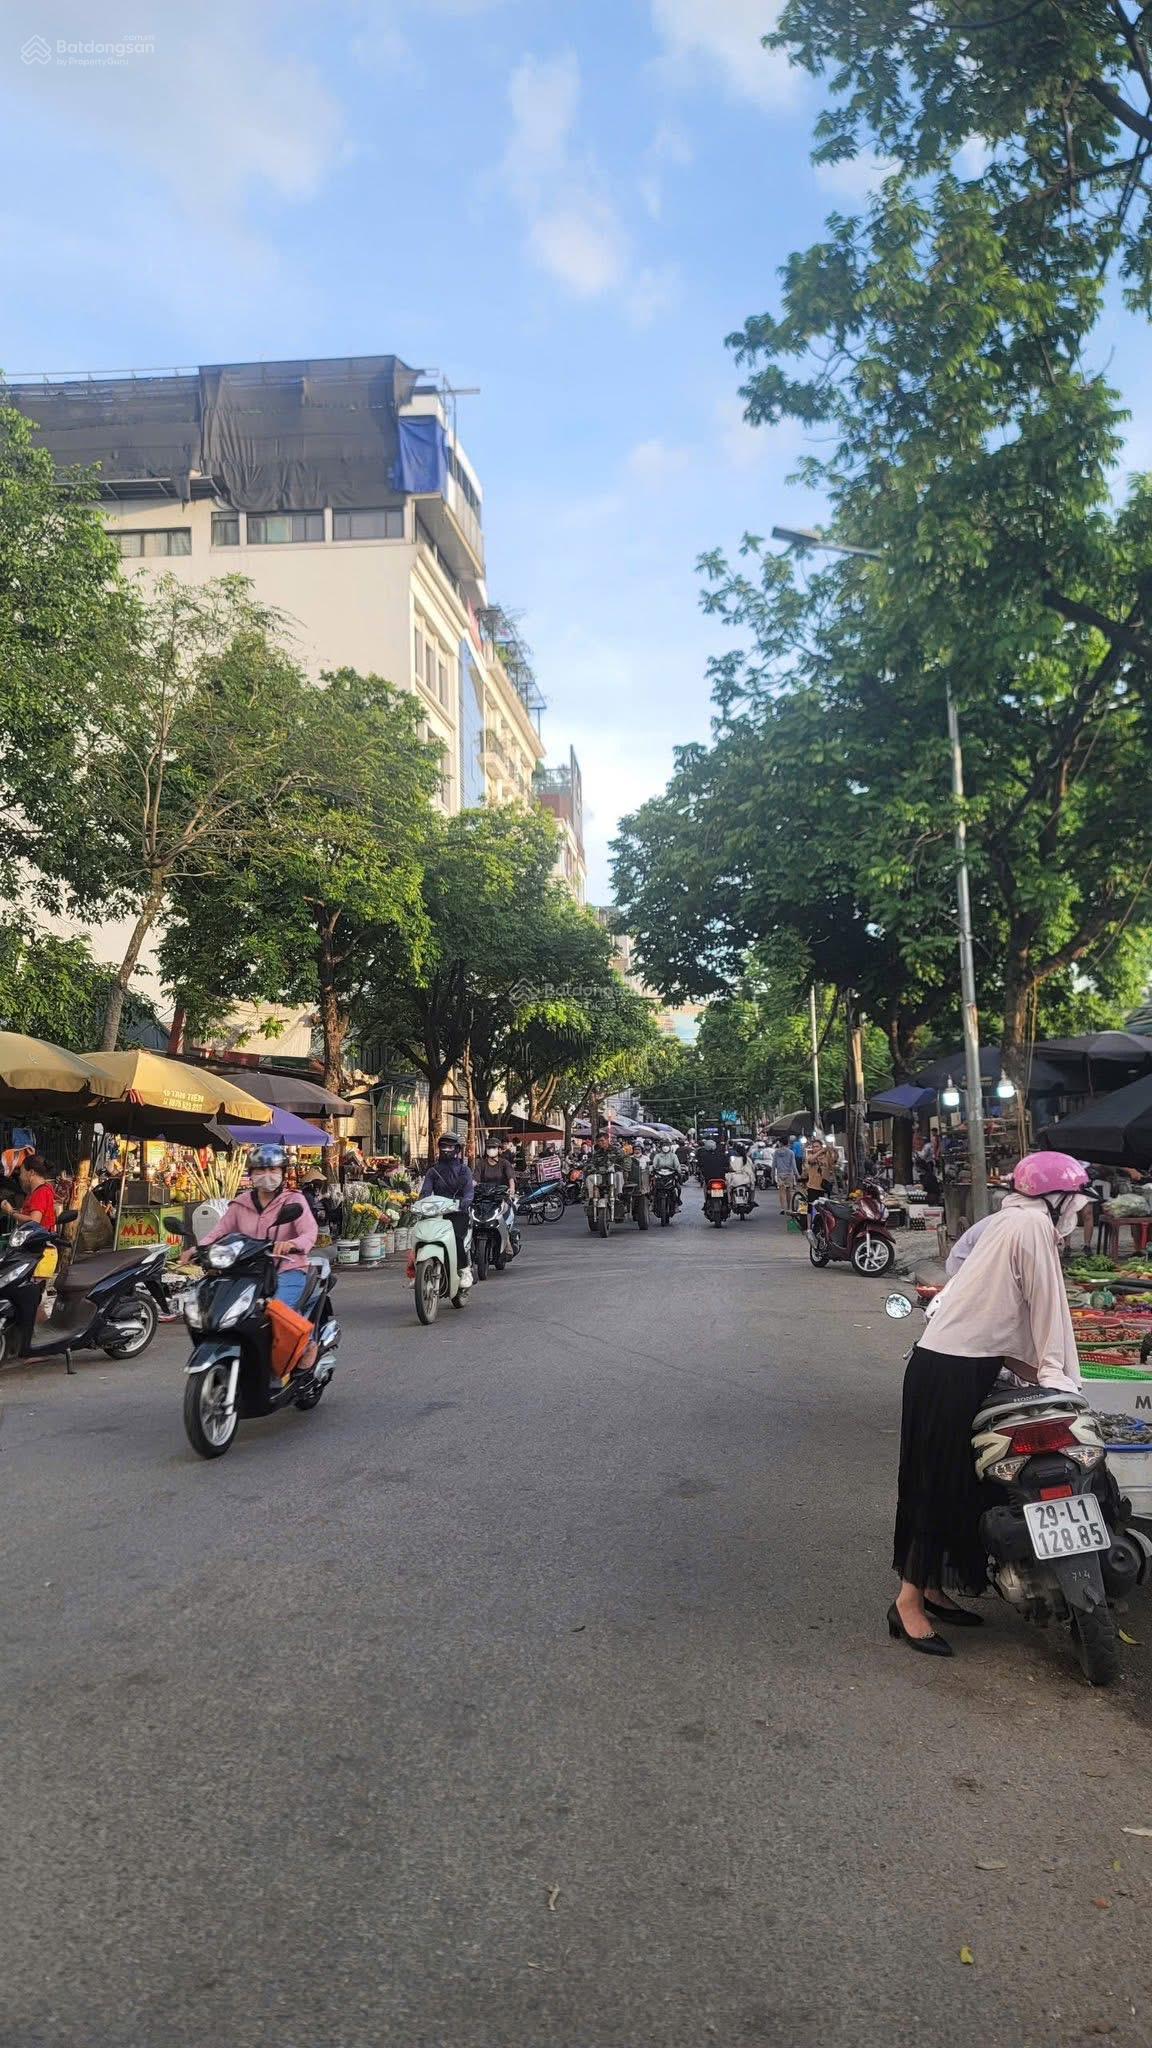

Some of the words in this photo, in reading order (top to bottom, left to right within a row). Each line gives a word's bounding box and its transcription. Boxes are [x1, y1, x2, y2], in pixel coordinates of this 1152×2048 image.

[1013, 1393, 1045, 1403] HONDA
[1035, 1499, 1090, 1530] 29-L1
[1038, 1522, 1104, 1554] 128.85
